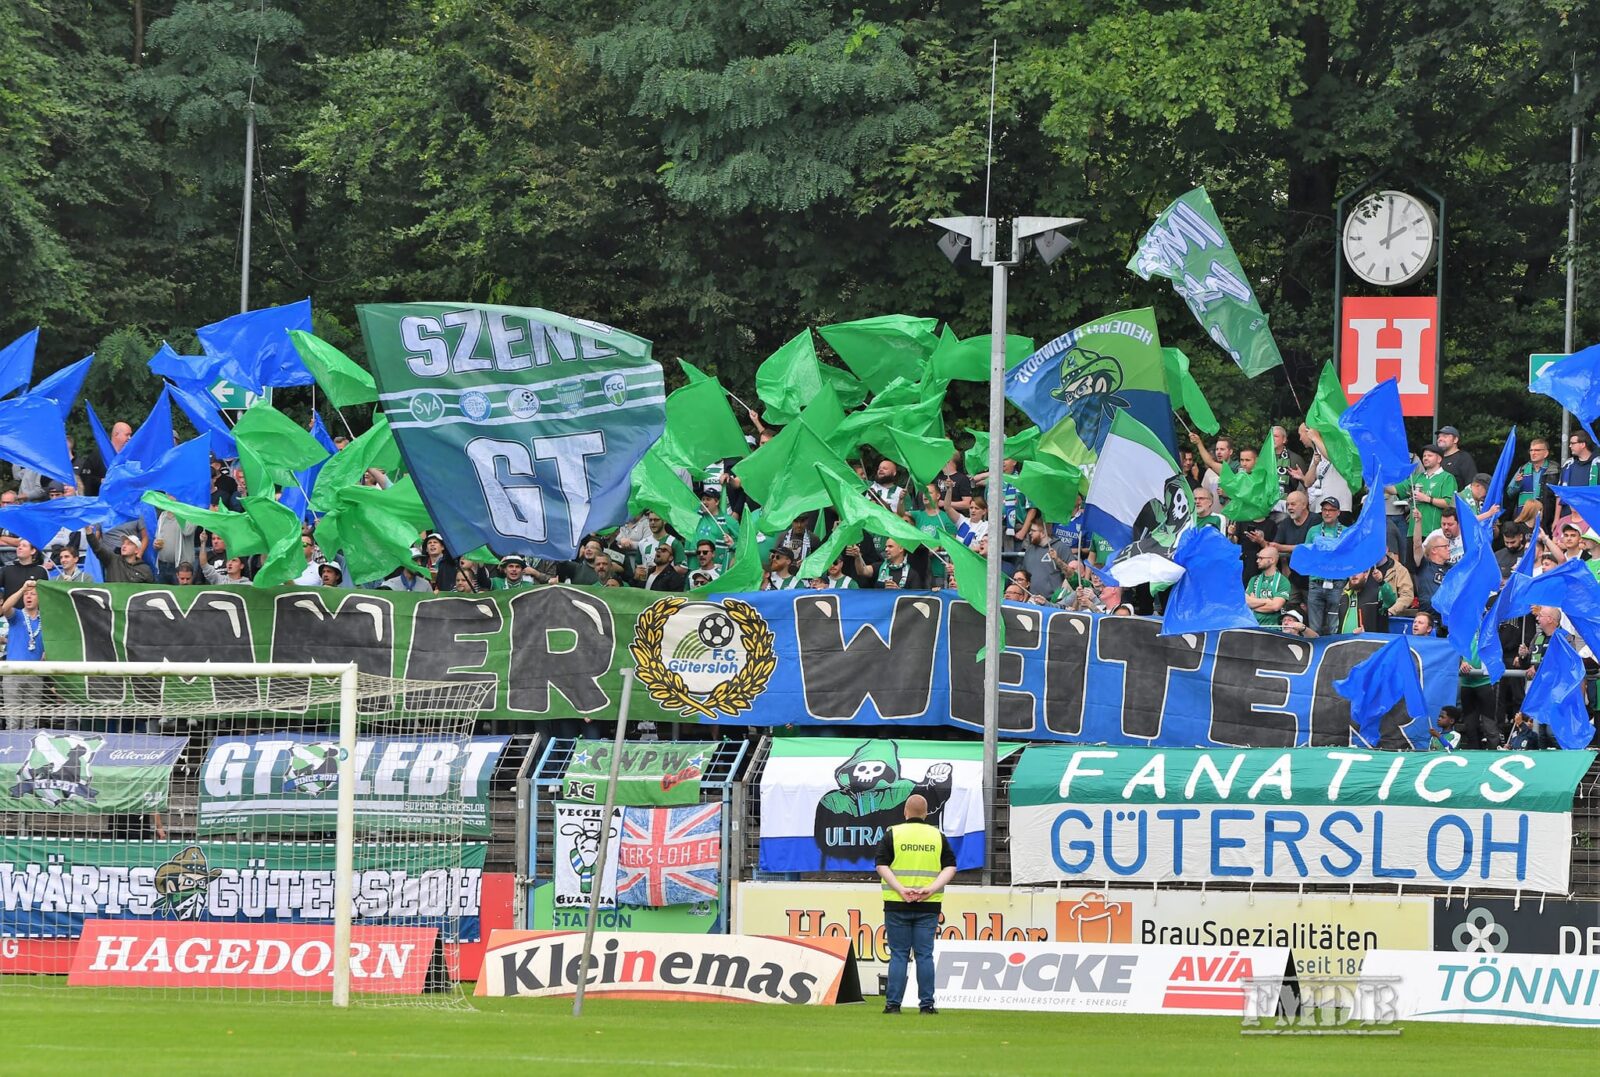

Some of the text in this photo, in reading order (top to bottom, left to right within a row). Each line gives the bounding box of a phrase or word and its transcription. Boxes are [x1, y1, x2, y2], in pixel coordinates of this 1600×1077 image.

[1348, 318, 1431, 394] H
[605, 381, 624, 393] FCG
[464, 429, 606, 548] GT
[67, 584, 1425, 750] IMMER WEITER
[668, 659, 738, 674] Gütersloh
[712, 648, 740, 661] F.C.
[203, 740, 505, 798] GT LEBT
[1057, 749, 1537, 804] FANATICS
[558, 807, 622, 818] VECCHA
[825, 825, 890, 847] ULTRA
[900, 843, 936, 853] ORDNER
[1050, 808, 1529, 882] GÜTERSLOH
[555, 894, 615, 906] GUARIA
[552, 911, 632, 929] STAION
[785, 908, 1049, 964] Hoheelder
[1141, 919, 1378, 951] BrauSpezialitäten
[88, 934, 416, 980] HAGEDORN
[1296, 956, 1331, 975] seit
[500, 938, 818, 1005] Kleinemas
[1000, 996, 1076, 1006] SCHMIERSTOFFE
[1085, 998, 1128, 1008] ENERGIE
